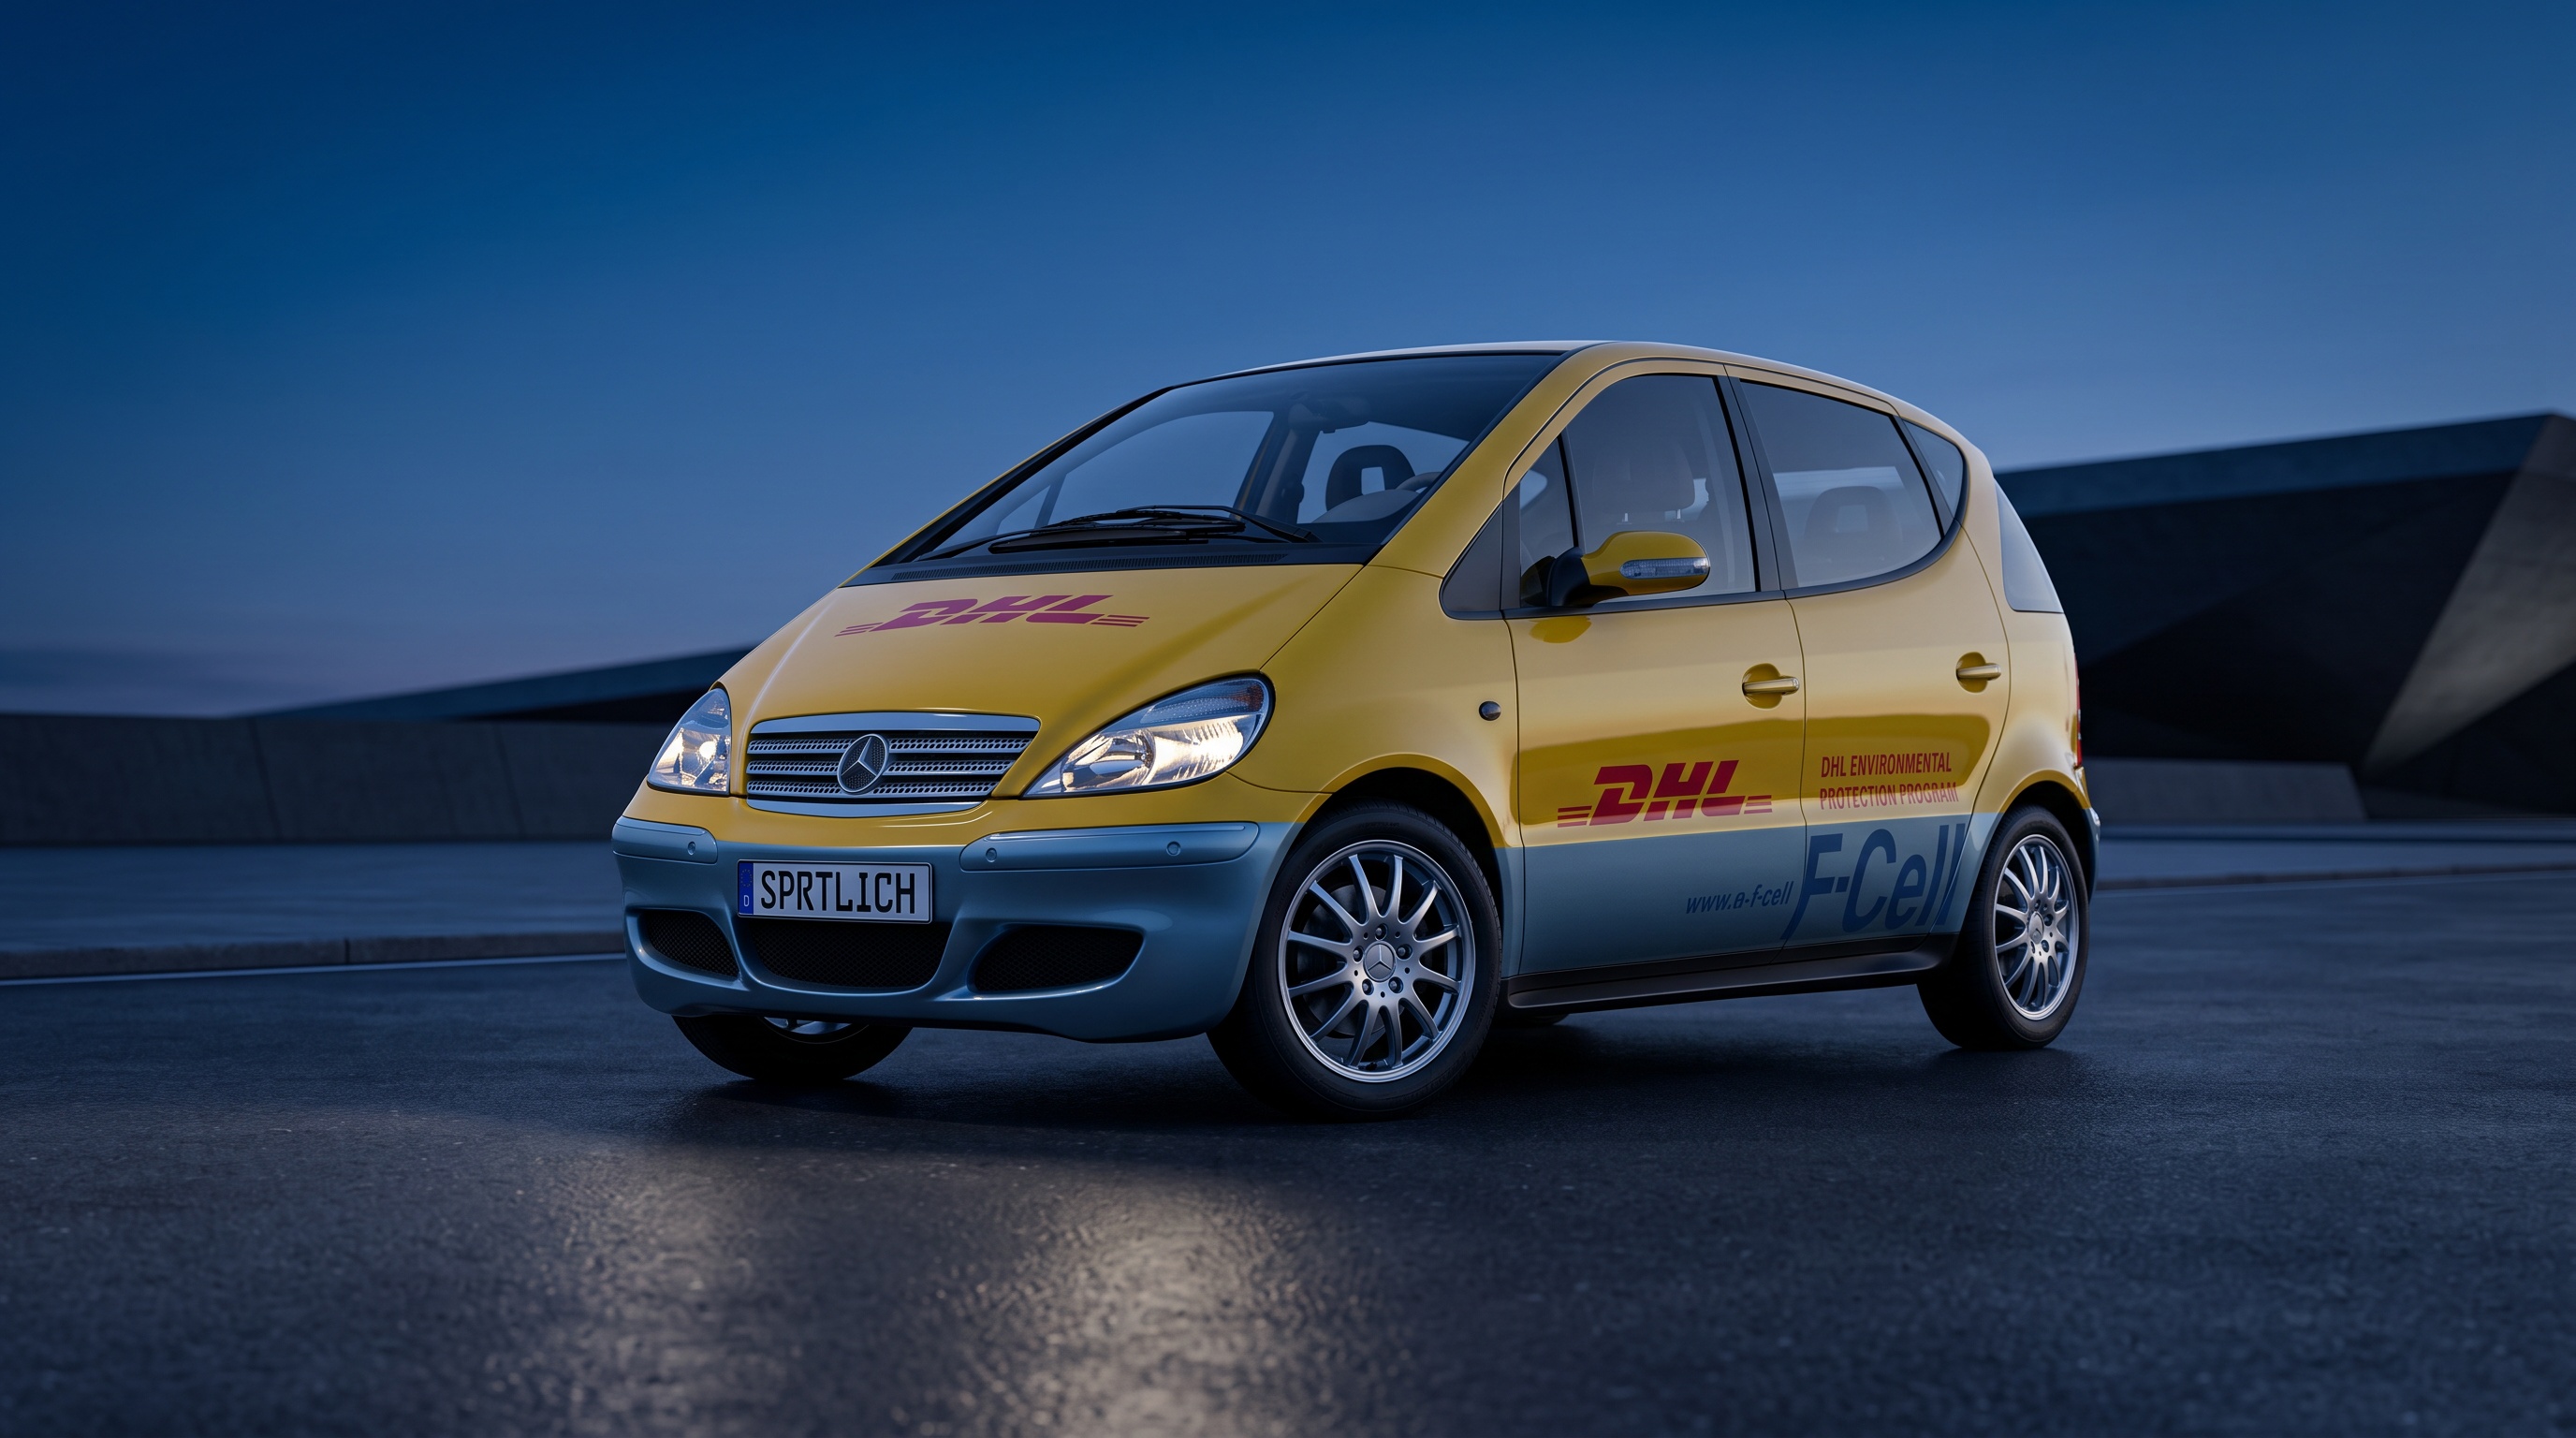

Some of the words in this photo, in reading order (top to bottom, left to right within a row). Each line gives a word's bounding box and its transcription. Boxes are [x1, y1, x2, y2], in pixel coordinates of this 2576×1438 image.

[869, 594, 1114, 632] DHL
[1821, 756, 1846, 777] DHL
[1851, 753, 1952, 776] ENVIRONMENTAL
[1589, 759, 1739, 827] DHL
[1820, 785, 1896, 810] PROTECTION
[1899, 782, 1959, 804] PROGRAM
[743, 894, 750, 907] D
[760, 870, 915, 915] SPRTLICH
[1780, 824, 1966, 940] F-Cell
